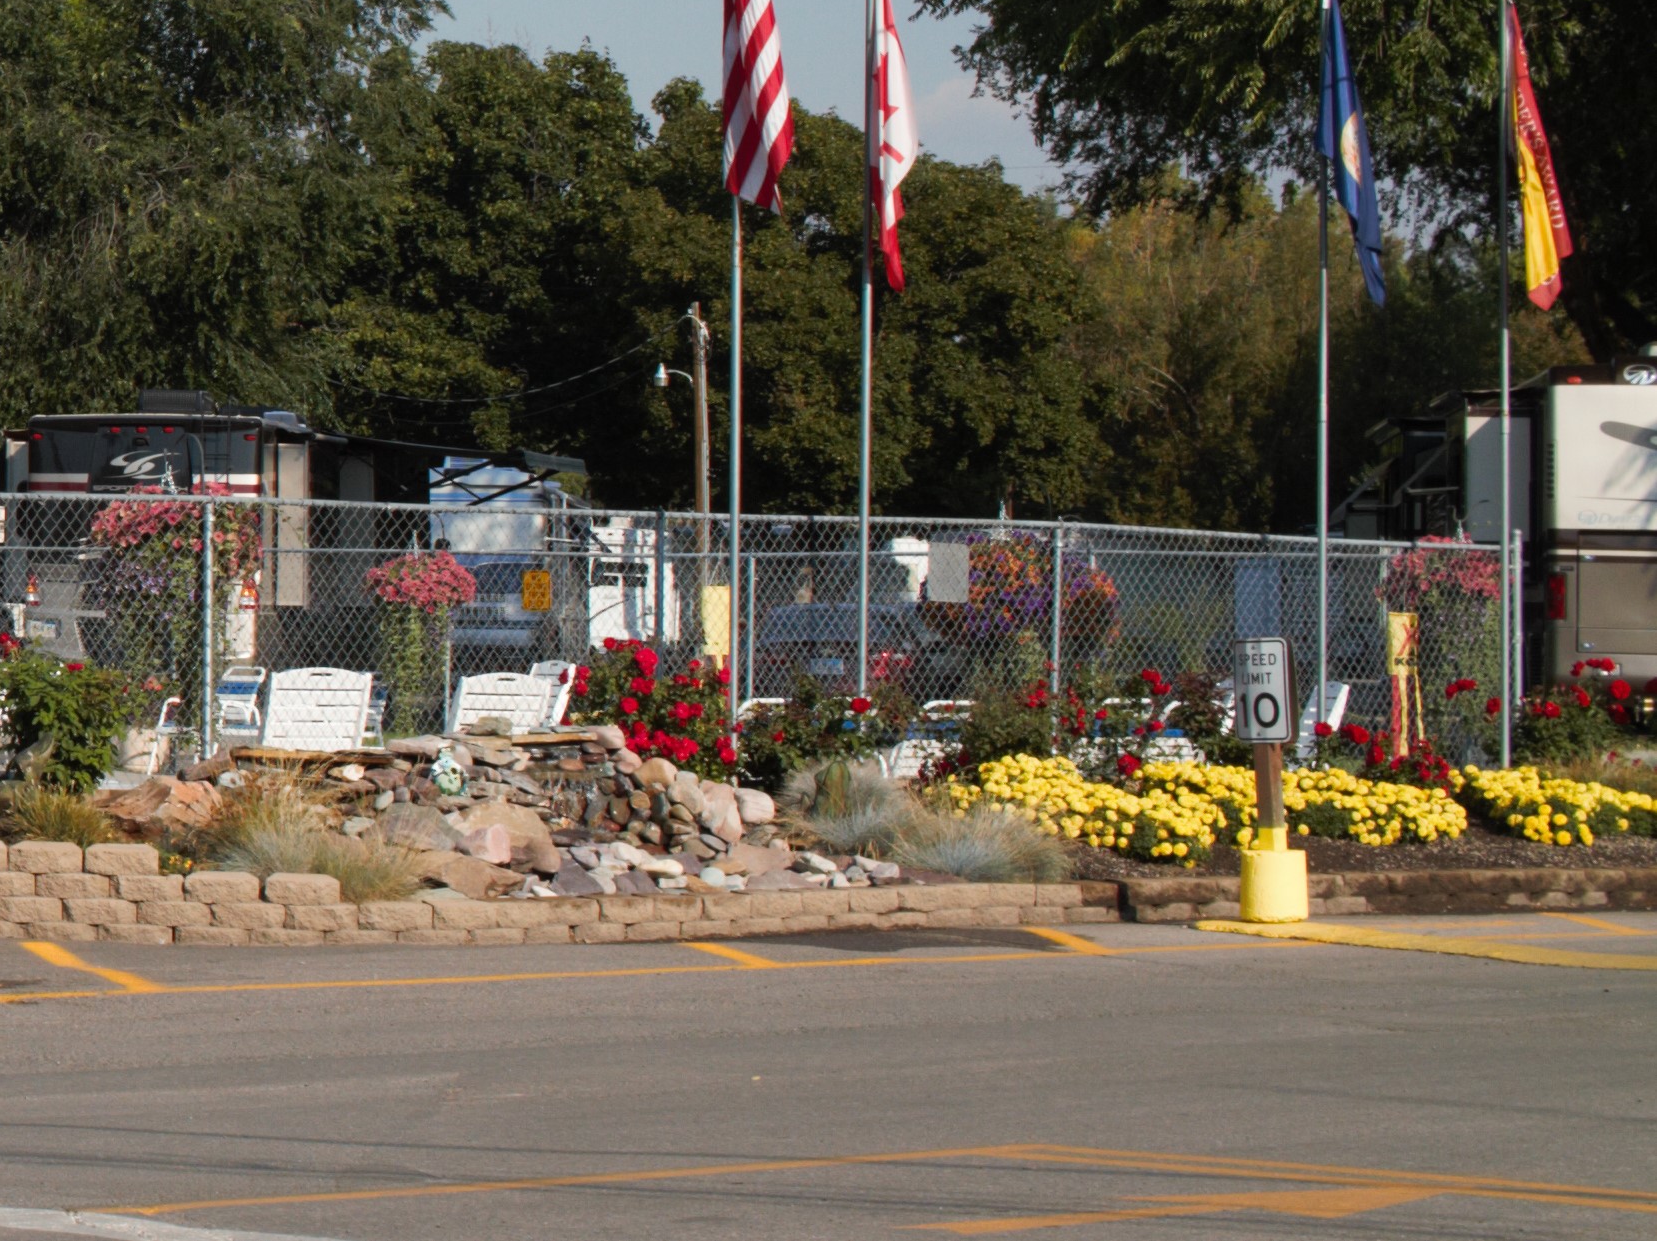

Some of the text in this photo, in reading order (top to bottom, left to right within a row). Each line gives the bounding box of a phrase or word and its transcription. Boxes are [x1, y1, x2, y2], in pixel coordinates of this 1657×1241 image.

[1238, 653, 1277, 666] SPEED
[1241, 672, 1272, 685] LIMIT
[1240, 692, 1280, 729] 10
